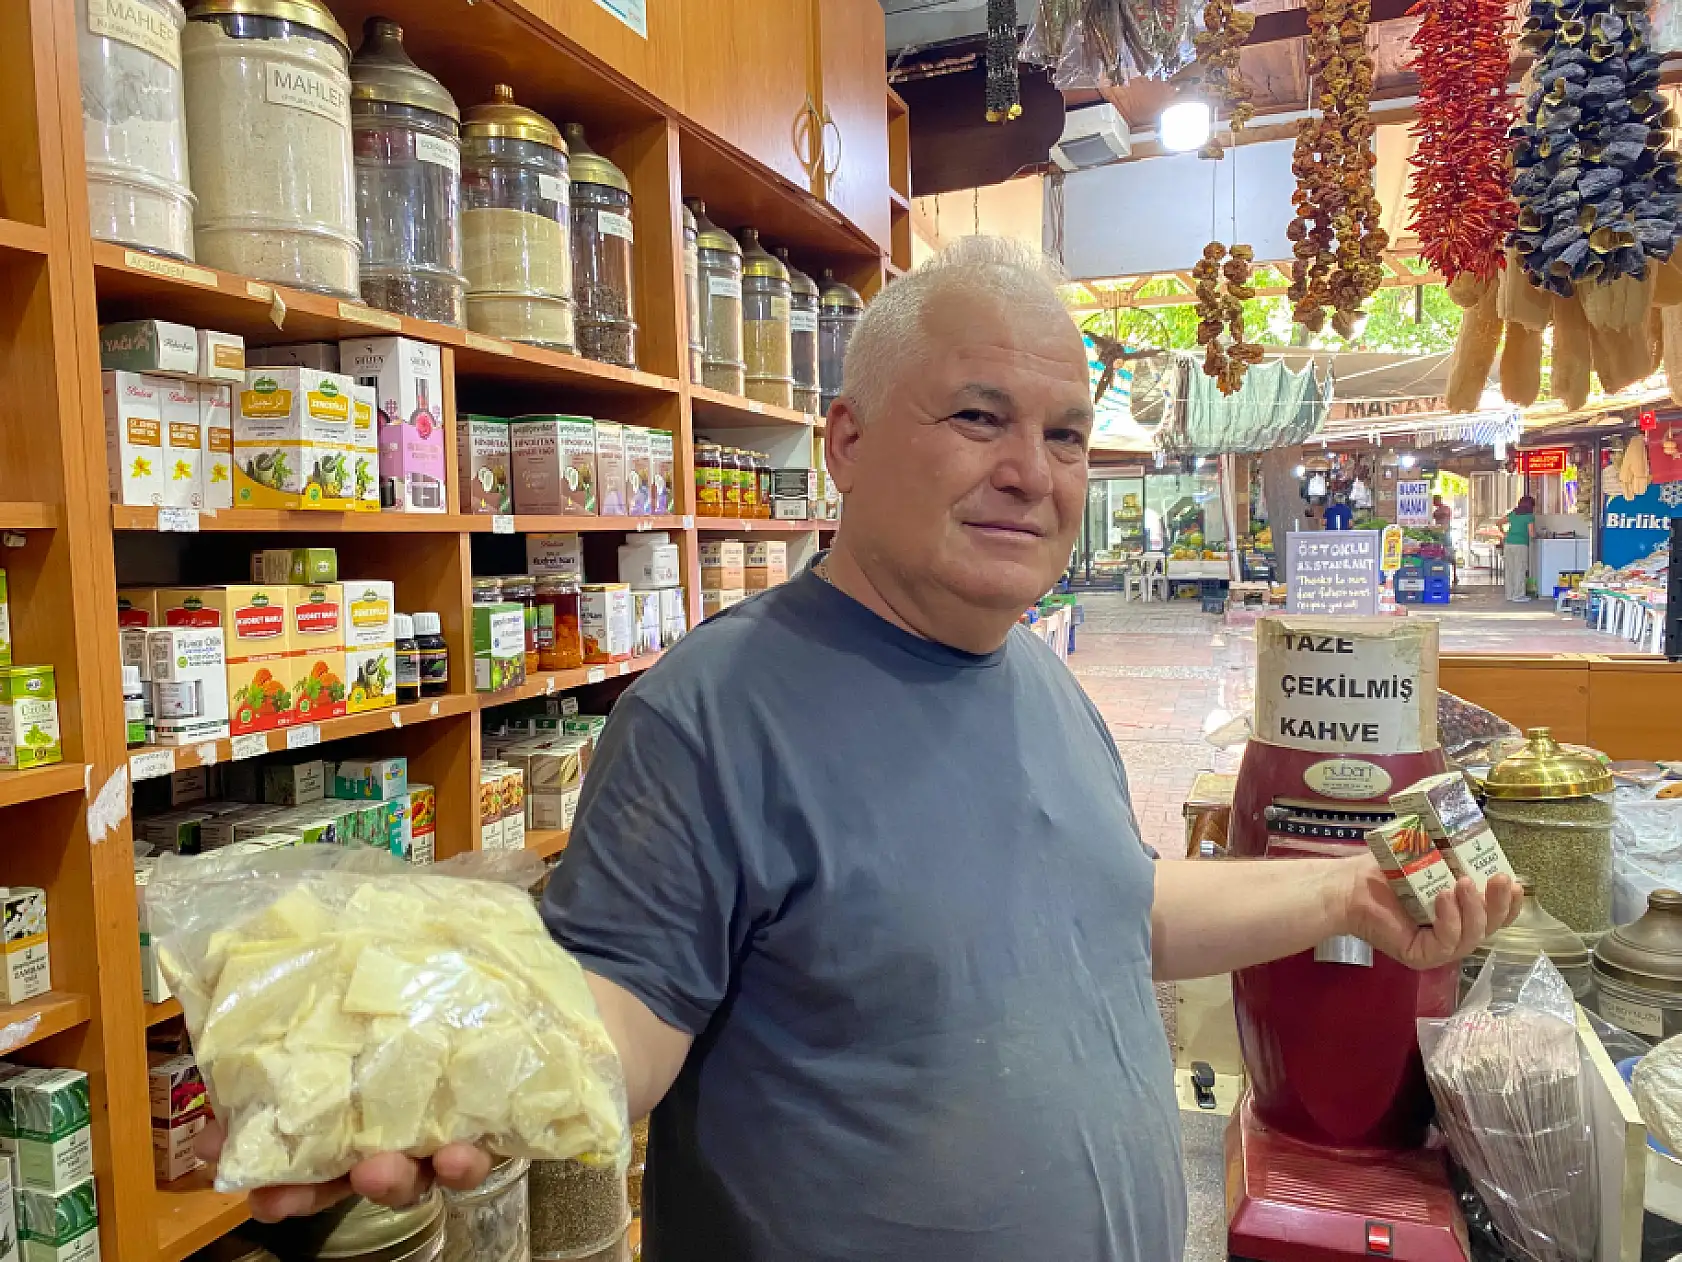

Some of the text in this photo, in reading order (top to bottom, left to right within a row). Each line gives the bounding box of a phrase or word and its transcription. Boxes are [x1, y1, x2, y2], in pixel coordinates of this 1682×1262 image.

[274, 69, 345, 108] MAHLEP
[1285, 635, 1354, 653] TAZE
[1281, 673, 1413, 703] ÇEKİLMİŞ
[1280, 716, 1379, 743] KAHVE
[1299, 825, 1306, 834] 3
[1311, 826, 1318, 835] 4
